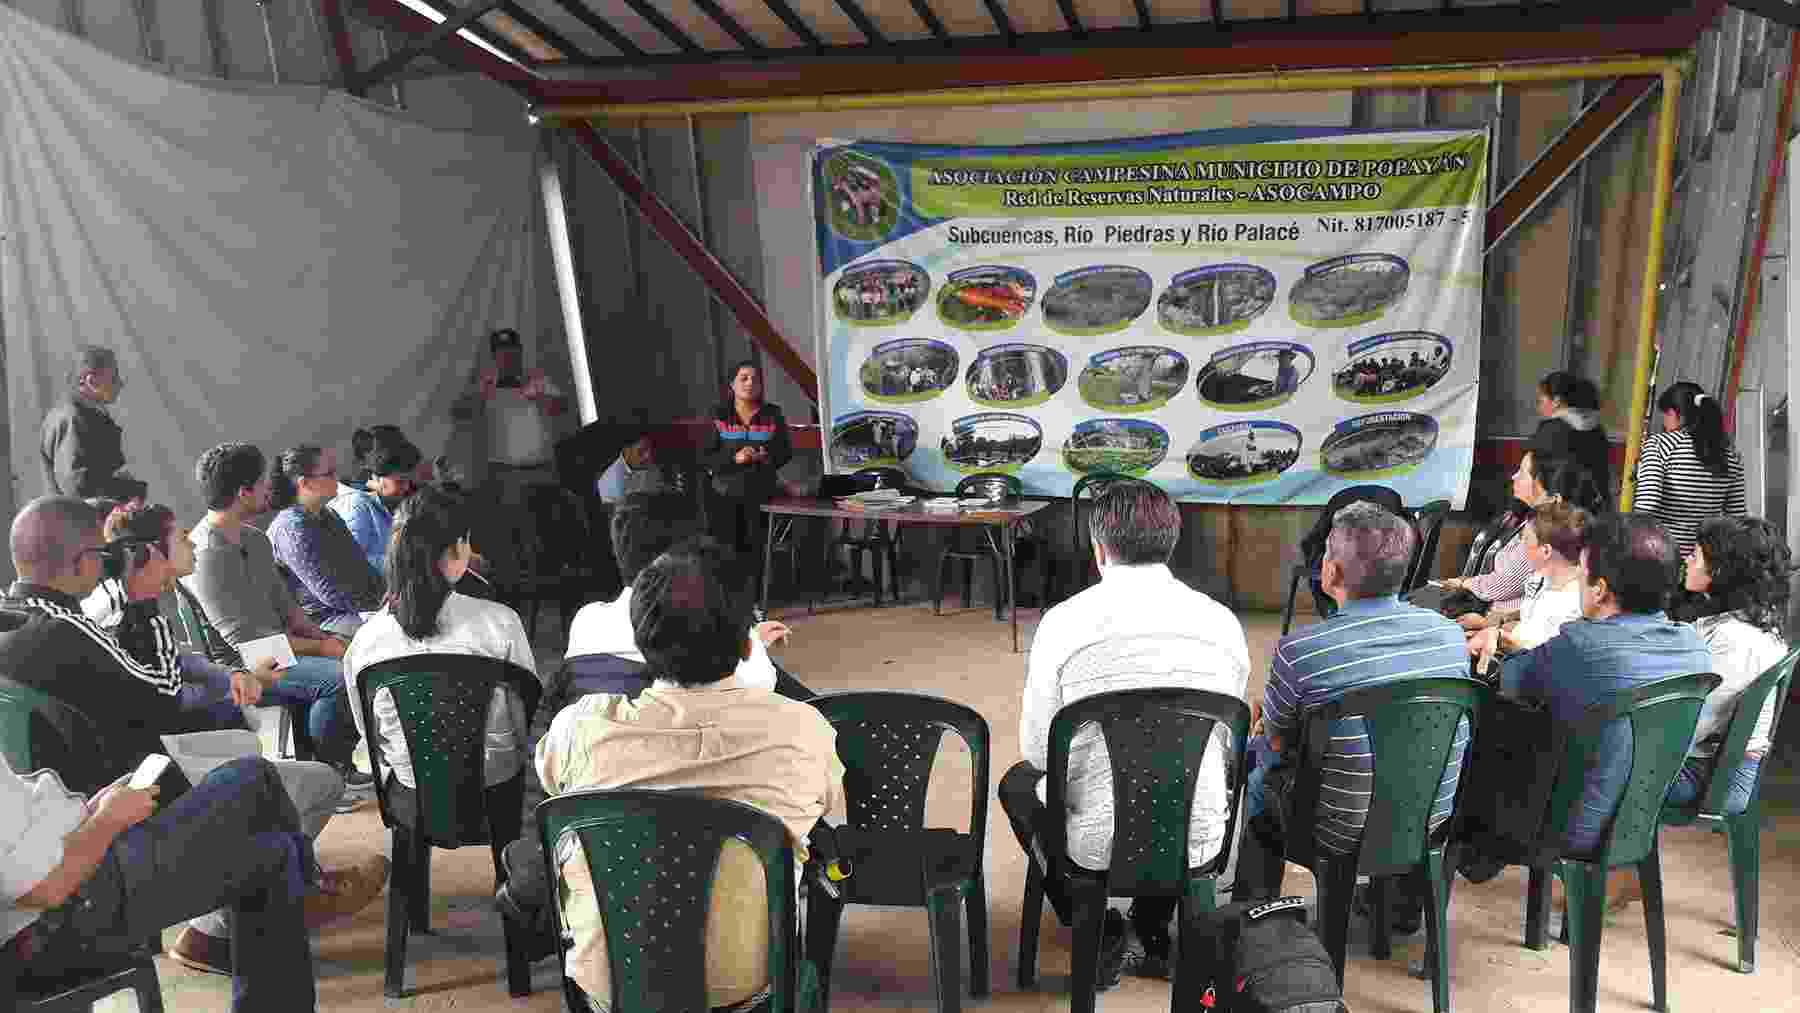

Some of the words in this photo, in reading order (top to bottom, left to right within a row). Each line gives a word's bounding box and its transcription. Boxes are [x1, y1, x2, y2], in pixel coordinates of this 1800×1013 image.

[1062, 161, 1193, 184] CAMPESINA
[1195, 158, 1321, 179] MUNICIPIO
[1327, 159, 1360, 177] DE
[1002, 189, 1038, 208] Red
[1041, 189, 1064, 207] de
[1065, 187, 1145, 206] Reservas
[1148, 185, 1233, 203] Naturales
[1249, 183, 1382, 201] ASOCAMPO
[949, 225, 1059, 247] Subcuencas,
[1105, 225, 1176, 243] Piedras
[1181, 227, 1191, 246] y
[1235, 221, 1300, 241] Palacé
[1317, 217, 1349, 233] Nit.
[1354, 211, 1445, 232] 817005187
